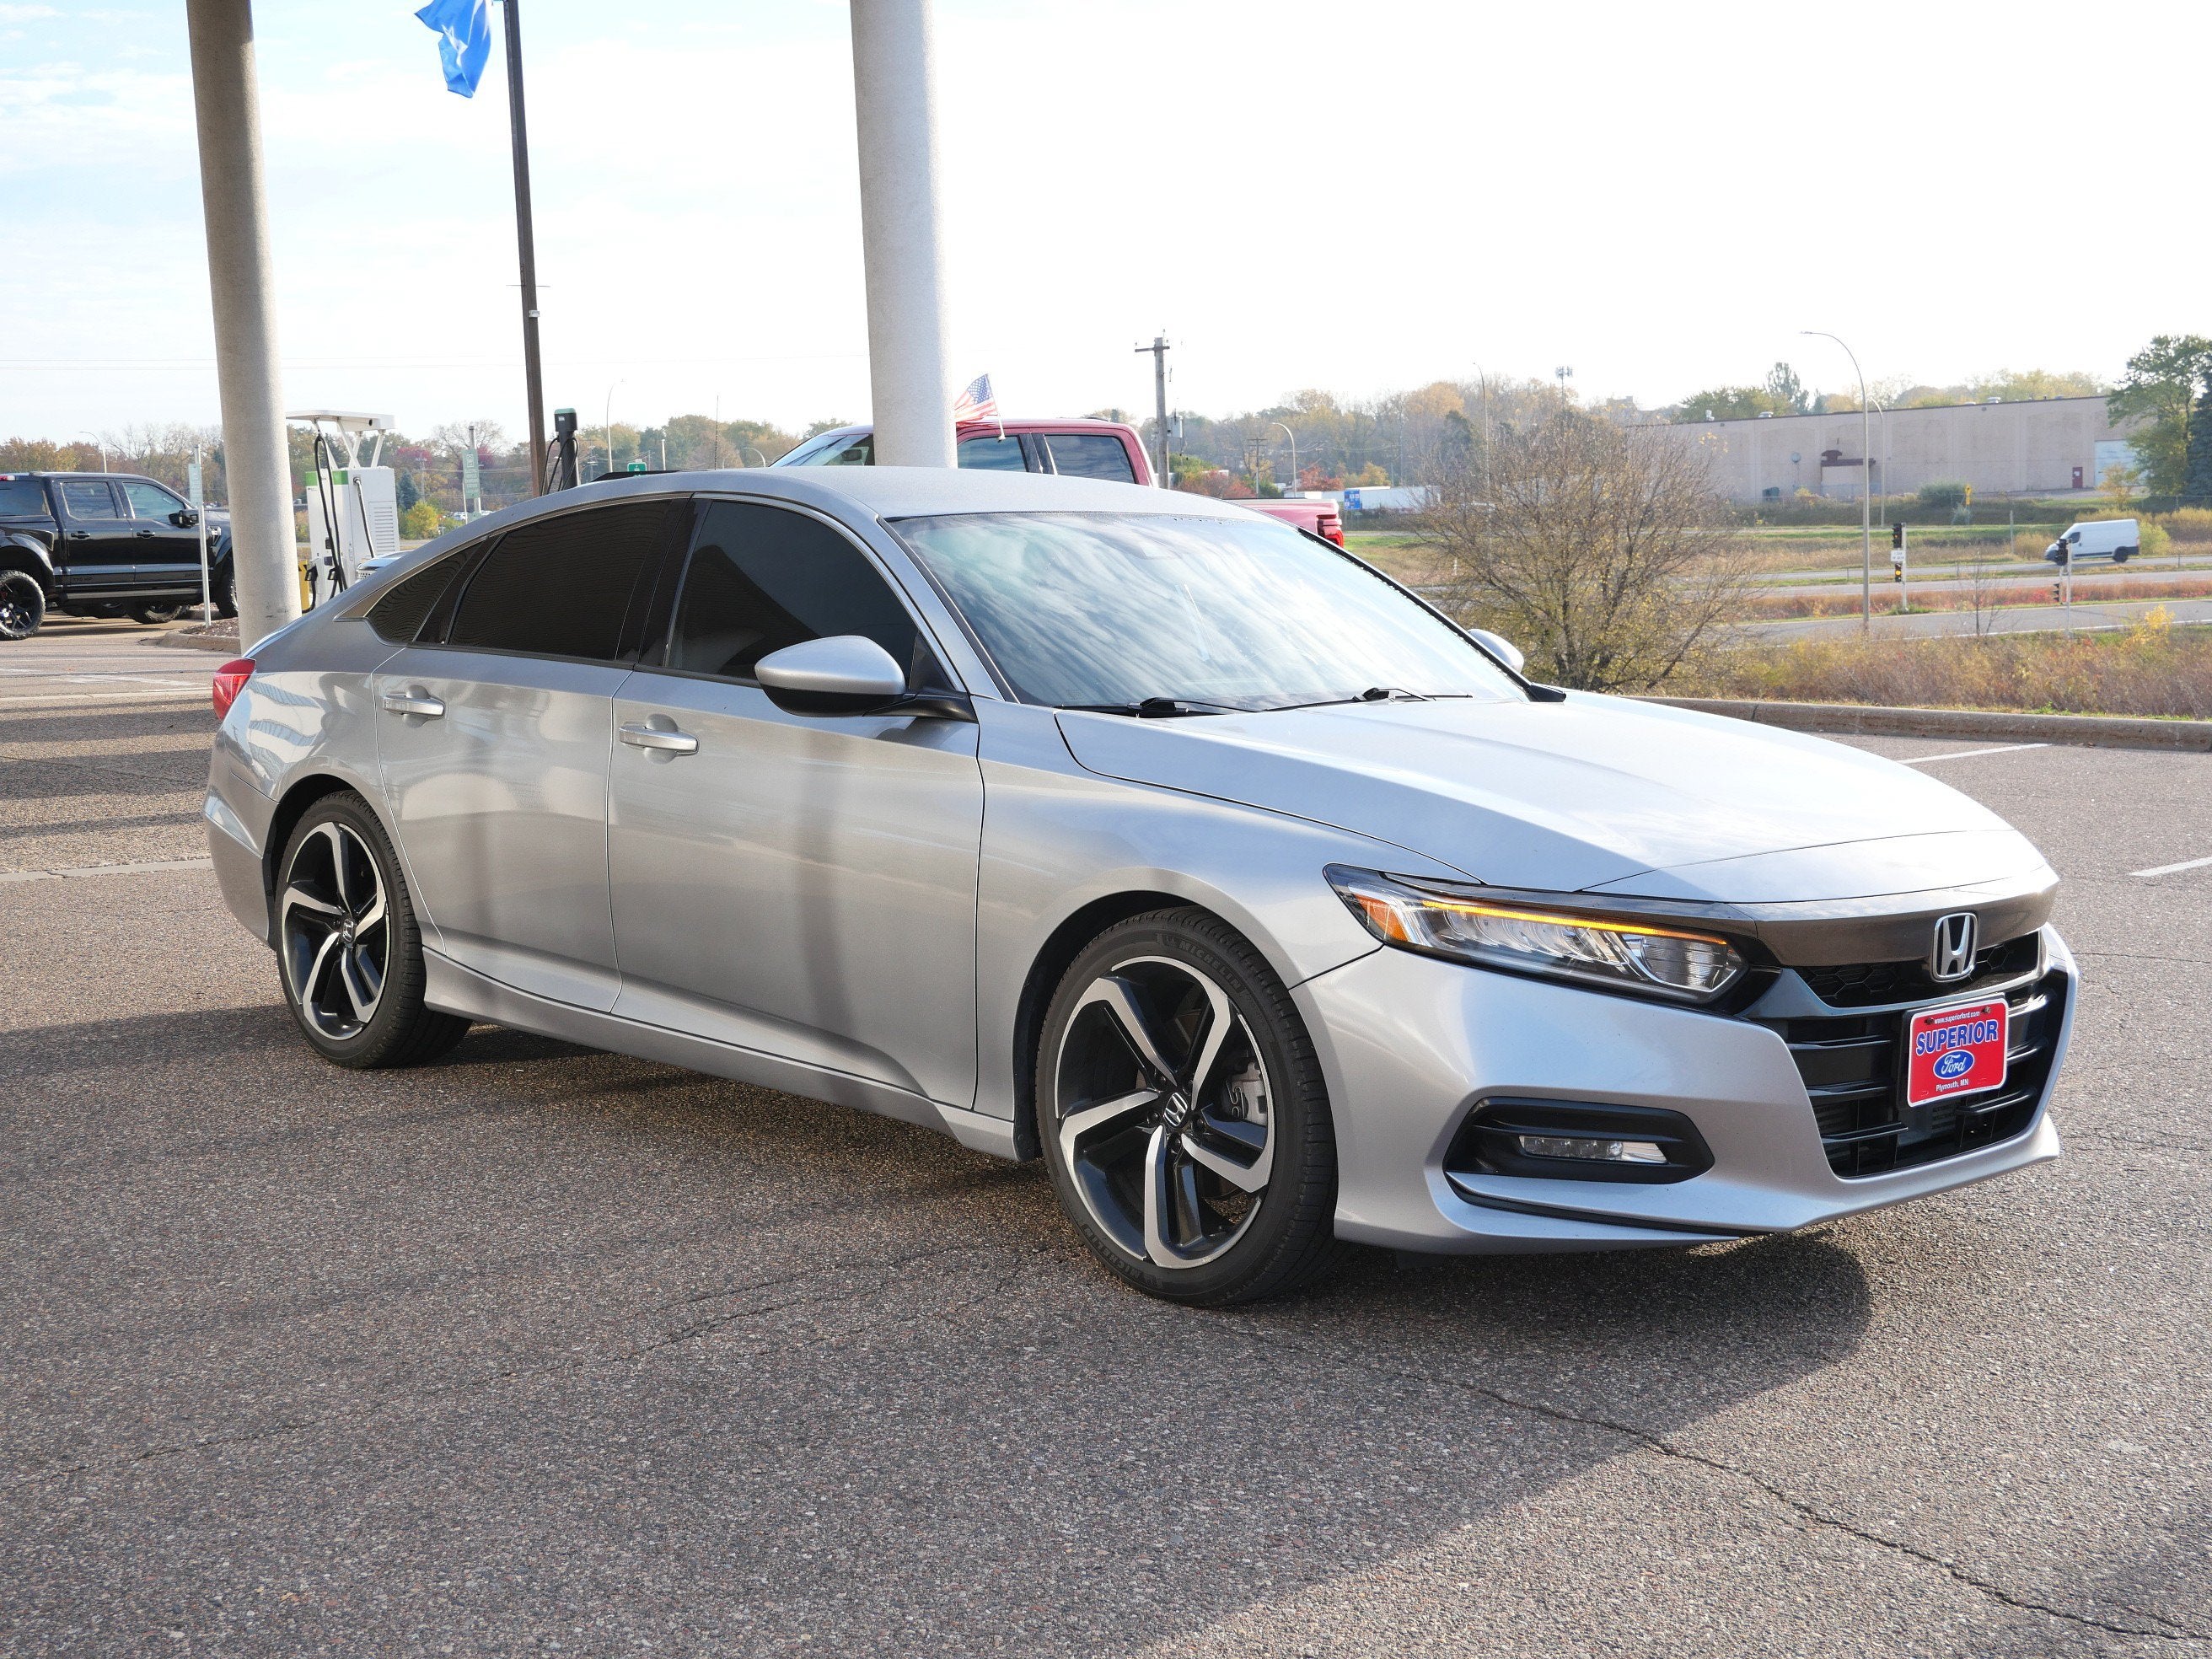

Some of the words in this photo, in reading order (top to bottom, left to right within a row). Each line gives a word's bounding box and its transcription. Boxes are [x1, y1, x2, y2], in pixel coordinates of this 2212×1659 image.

[1179, 940, 1243, 989] MICHELIN
[1934, 1011, 1980, 1024] www.superiorford.com
[1915, 1019, 1999, 1056] SUPERIOR
[1941, 1054, 1967, 1074] Ford
[1960, 1078, 1969, 1087] MN
[1083, 1227, 1141, 1280] MICHELIN
